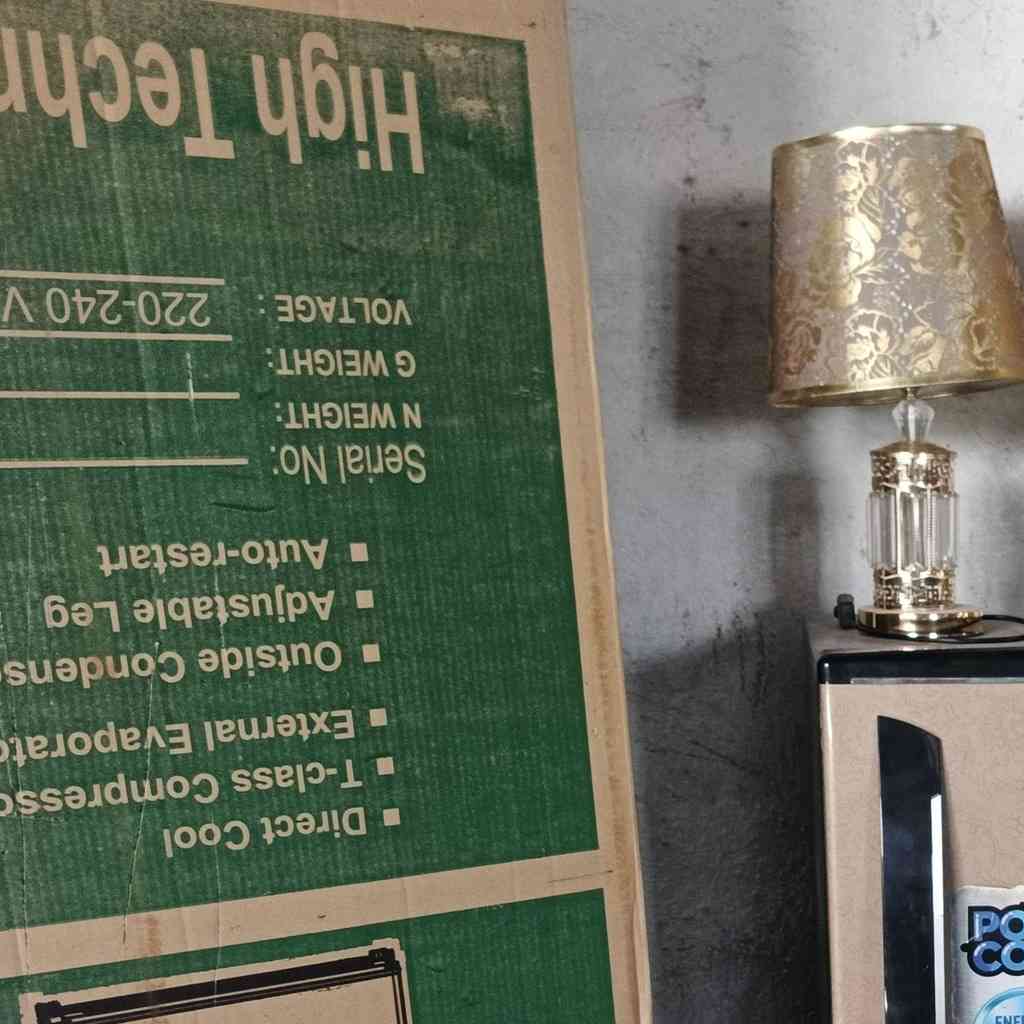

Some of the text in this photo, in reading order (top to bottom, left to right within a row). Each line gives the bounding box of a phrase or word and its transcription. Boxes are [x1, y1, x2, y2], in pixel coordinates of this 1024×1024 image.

[251, 32, 425, 174] High
[46, 288, 212, 327] 220-240
[267, 348, 416, 377] G WEIGHT:
[275, 402, 421, 429] N WEIGHT:
[271, 444, 427, 485] Serial No:
[98, 539, 330, 576] Auto-restart
[43, 584, 335, 632] Adjustable Leg
[0, 641, 342, 688] Outside Condens
[206, 708, 355, 751] External
[232, 759, 363, 791] T-class
[165, 806, 367, 857] Direct Cool
